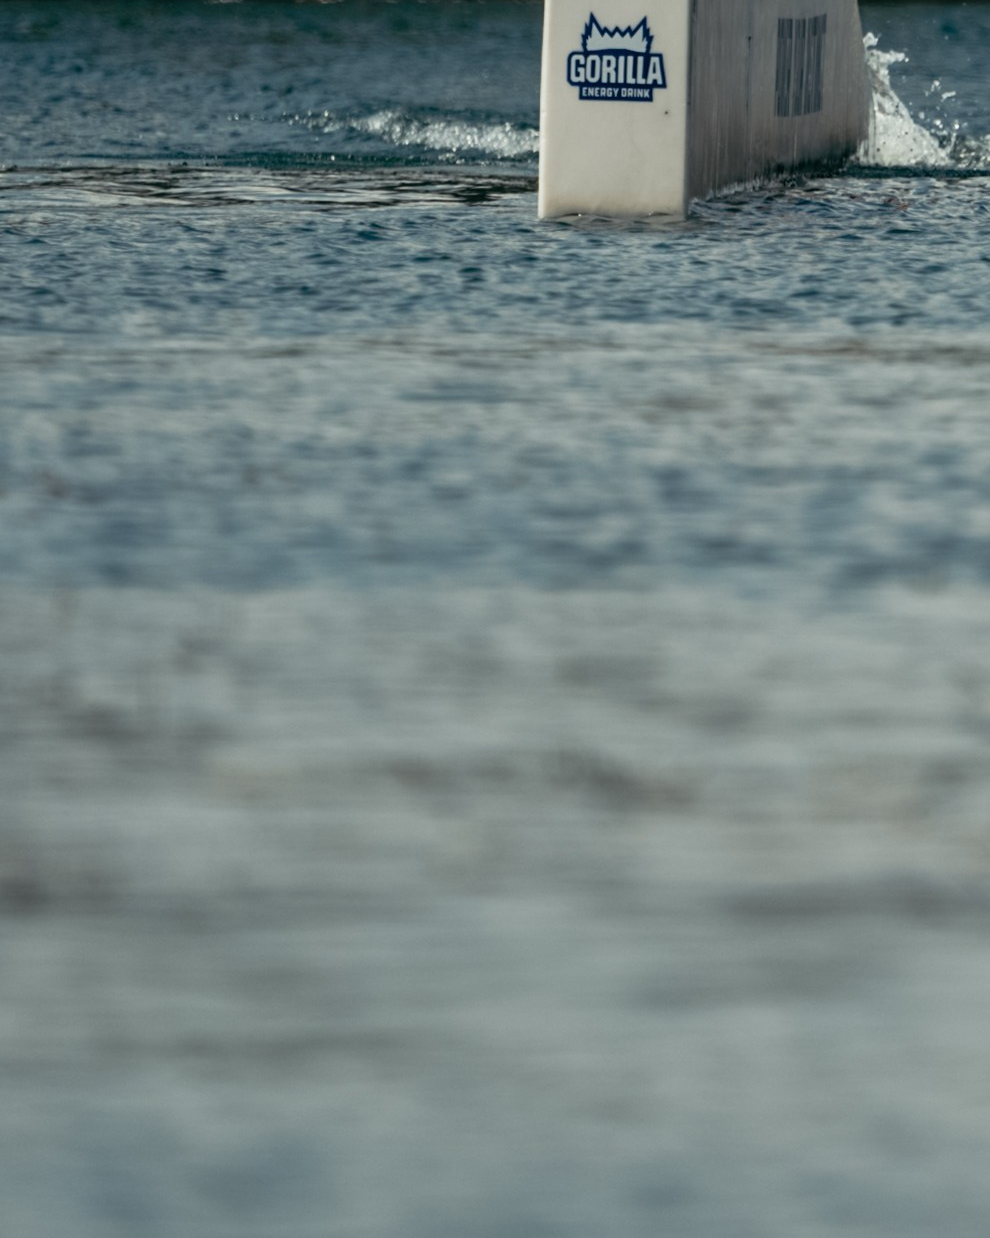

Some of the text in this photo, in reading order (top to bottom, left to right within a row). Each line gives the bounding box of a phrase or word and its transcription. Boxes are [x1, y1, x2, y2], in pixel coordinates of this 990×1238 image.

[570, 53, 663, 85] GORILLA
[581, 87, 651, 98] ENERGY DRINK
